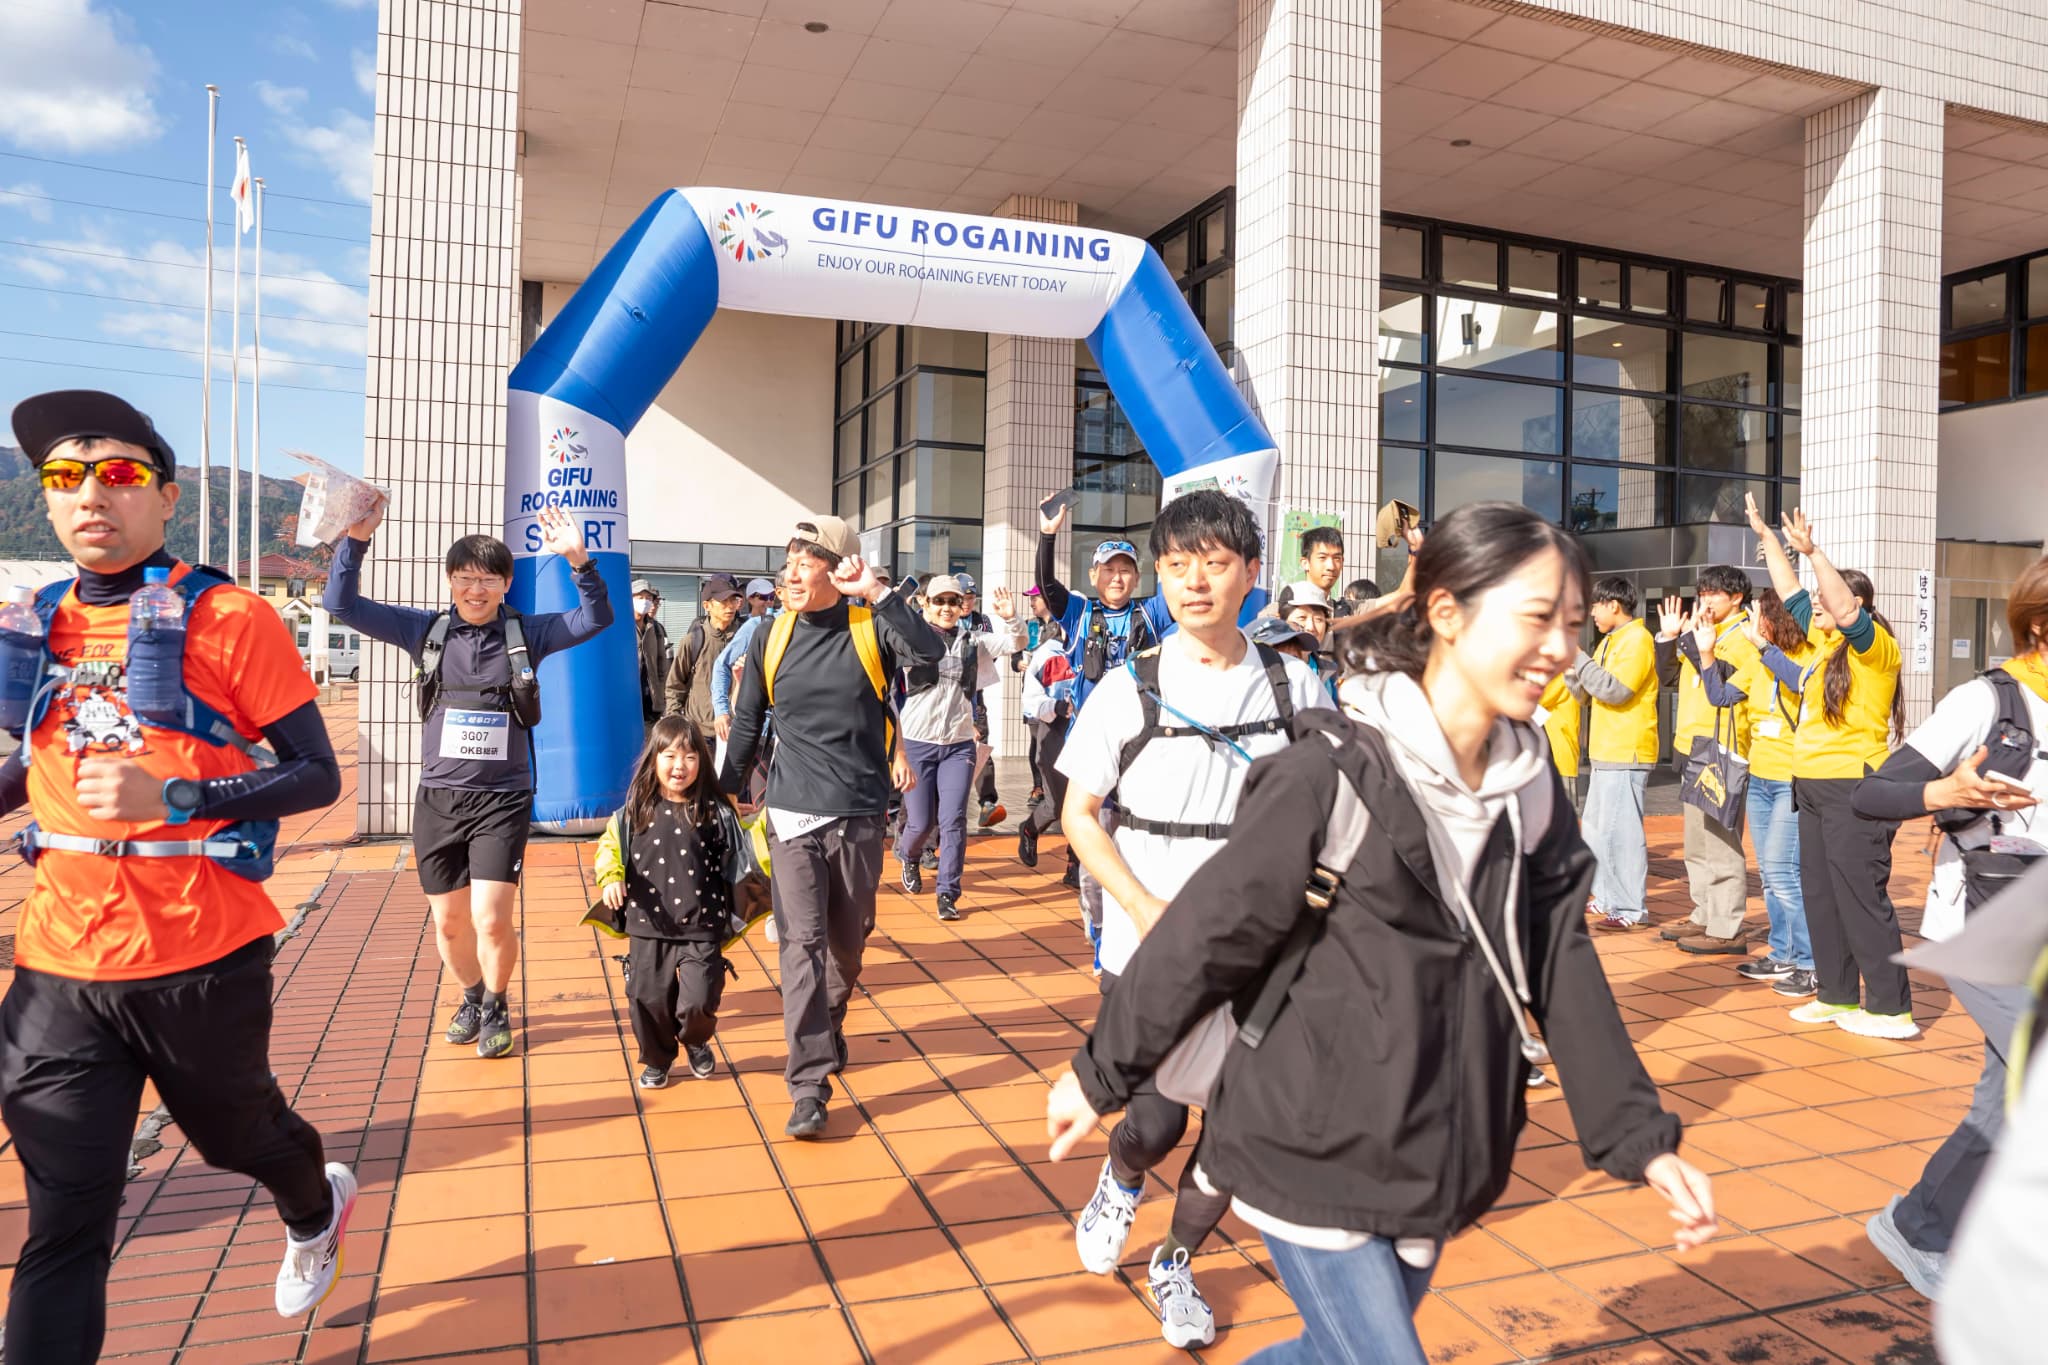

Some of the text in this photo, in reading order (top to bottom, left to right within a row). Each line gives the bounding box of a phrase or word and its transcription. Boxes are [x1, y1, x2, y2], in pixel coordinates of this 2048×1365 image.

[812, 207, 1111, 262] GIFU ROGAINING
[817, 253, 1068, 294] ENJOY OUR ROGAINING EVENT TODAY
[547, 467, 593, 487] GIFU
[520, 489, 618, 513] ROGAINING
[525, 520, 616, 552] SRT
